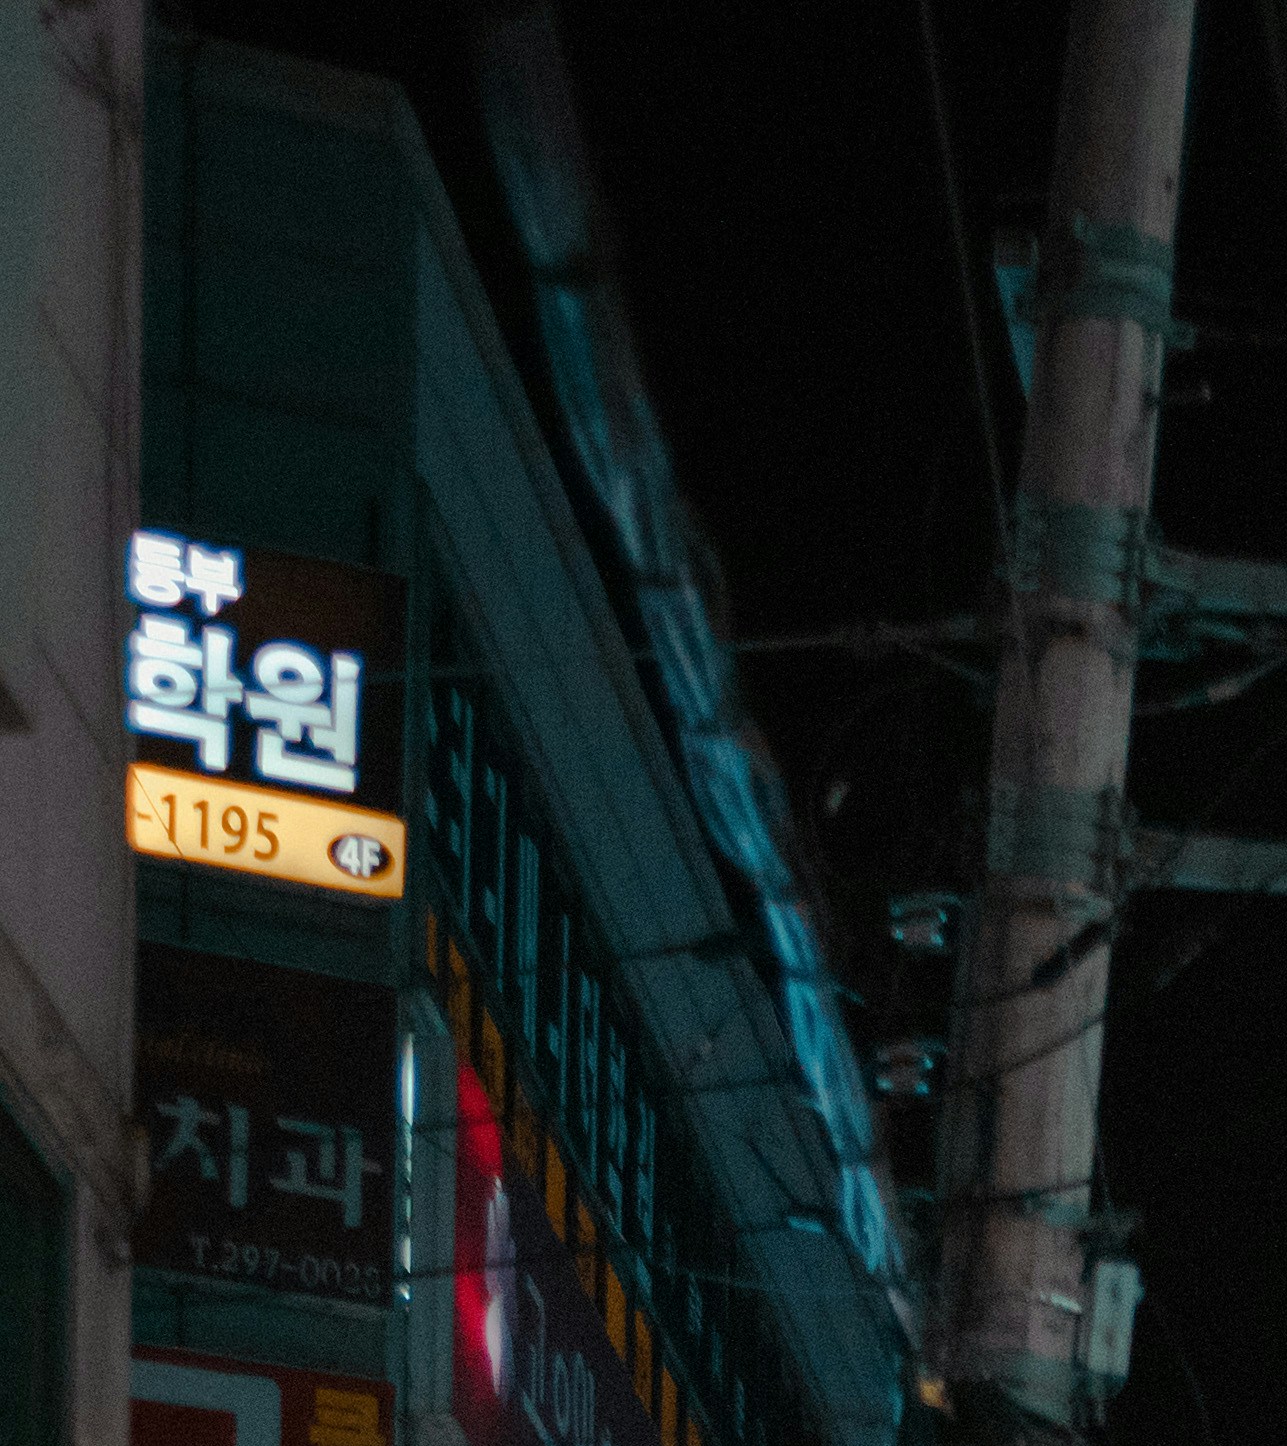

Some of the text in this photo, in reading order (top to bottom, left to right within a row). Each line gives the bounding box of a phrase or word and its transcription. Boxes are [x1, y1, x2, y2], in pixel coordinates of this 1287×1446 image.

[131, 614, 364, 793] 학원
[336, 836, 383, 881] 4F
[154, 1095, 384, 1230] 치과
